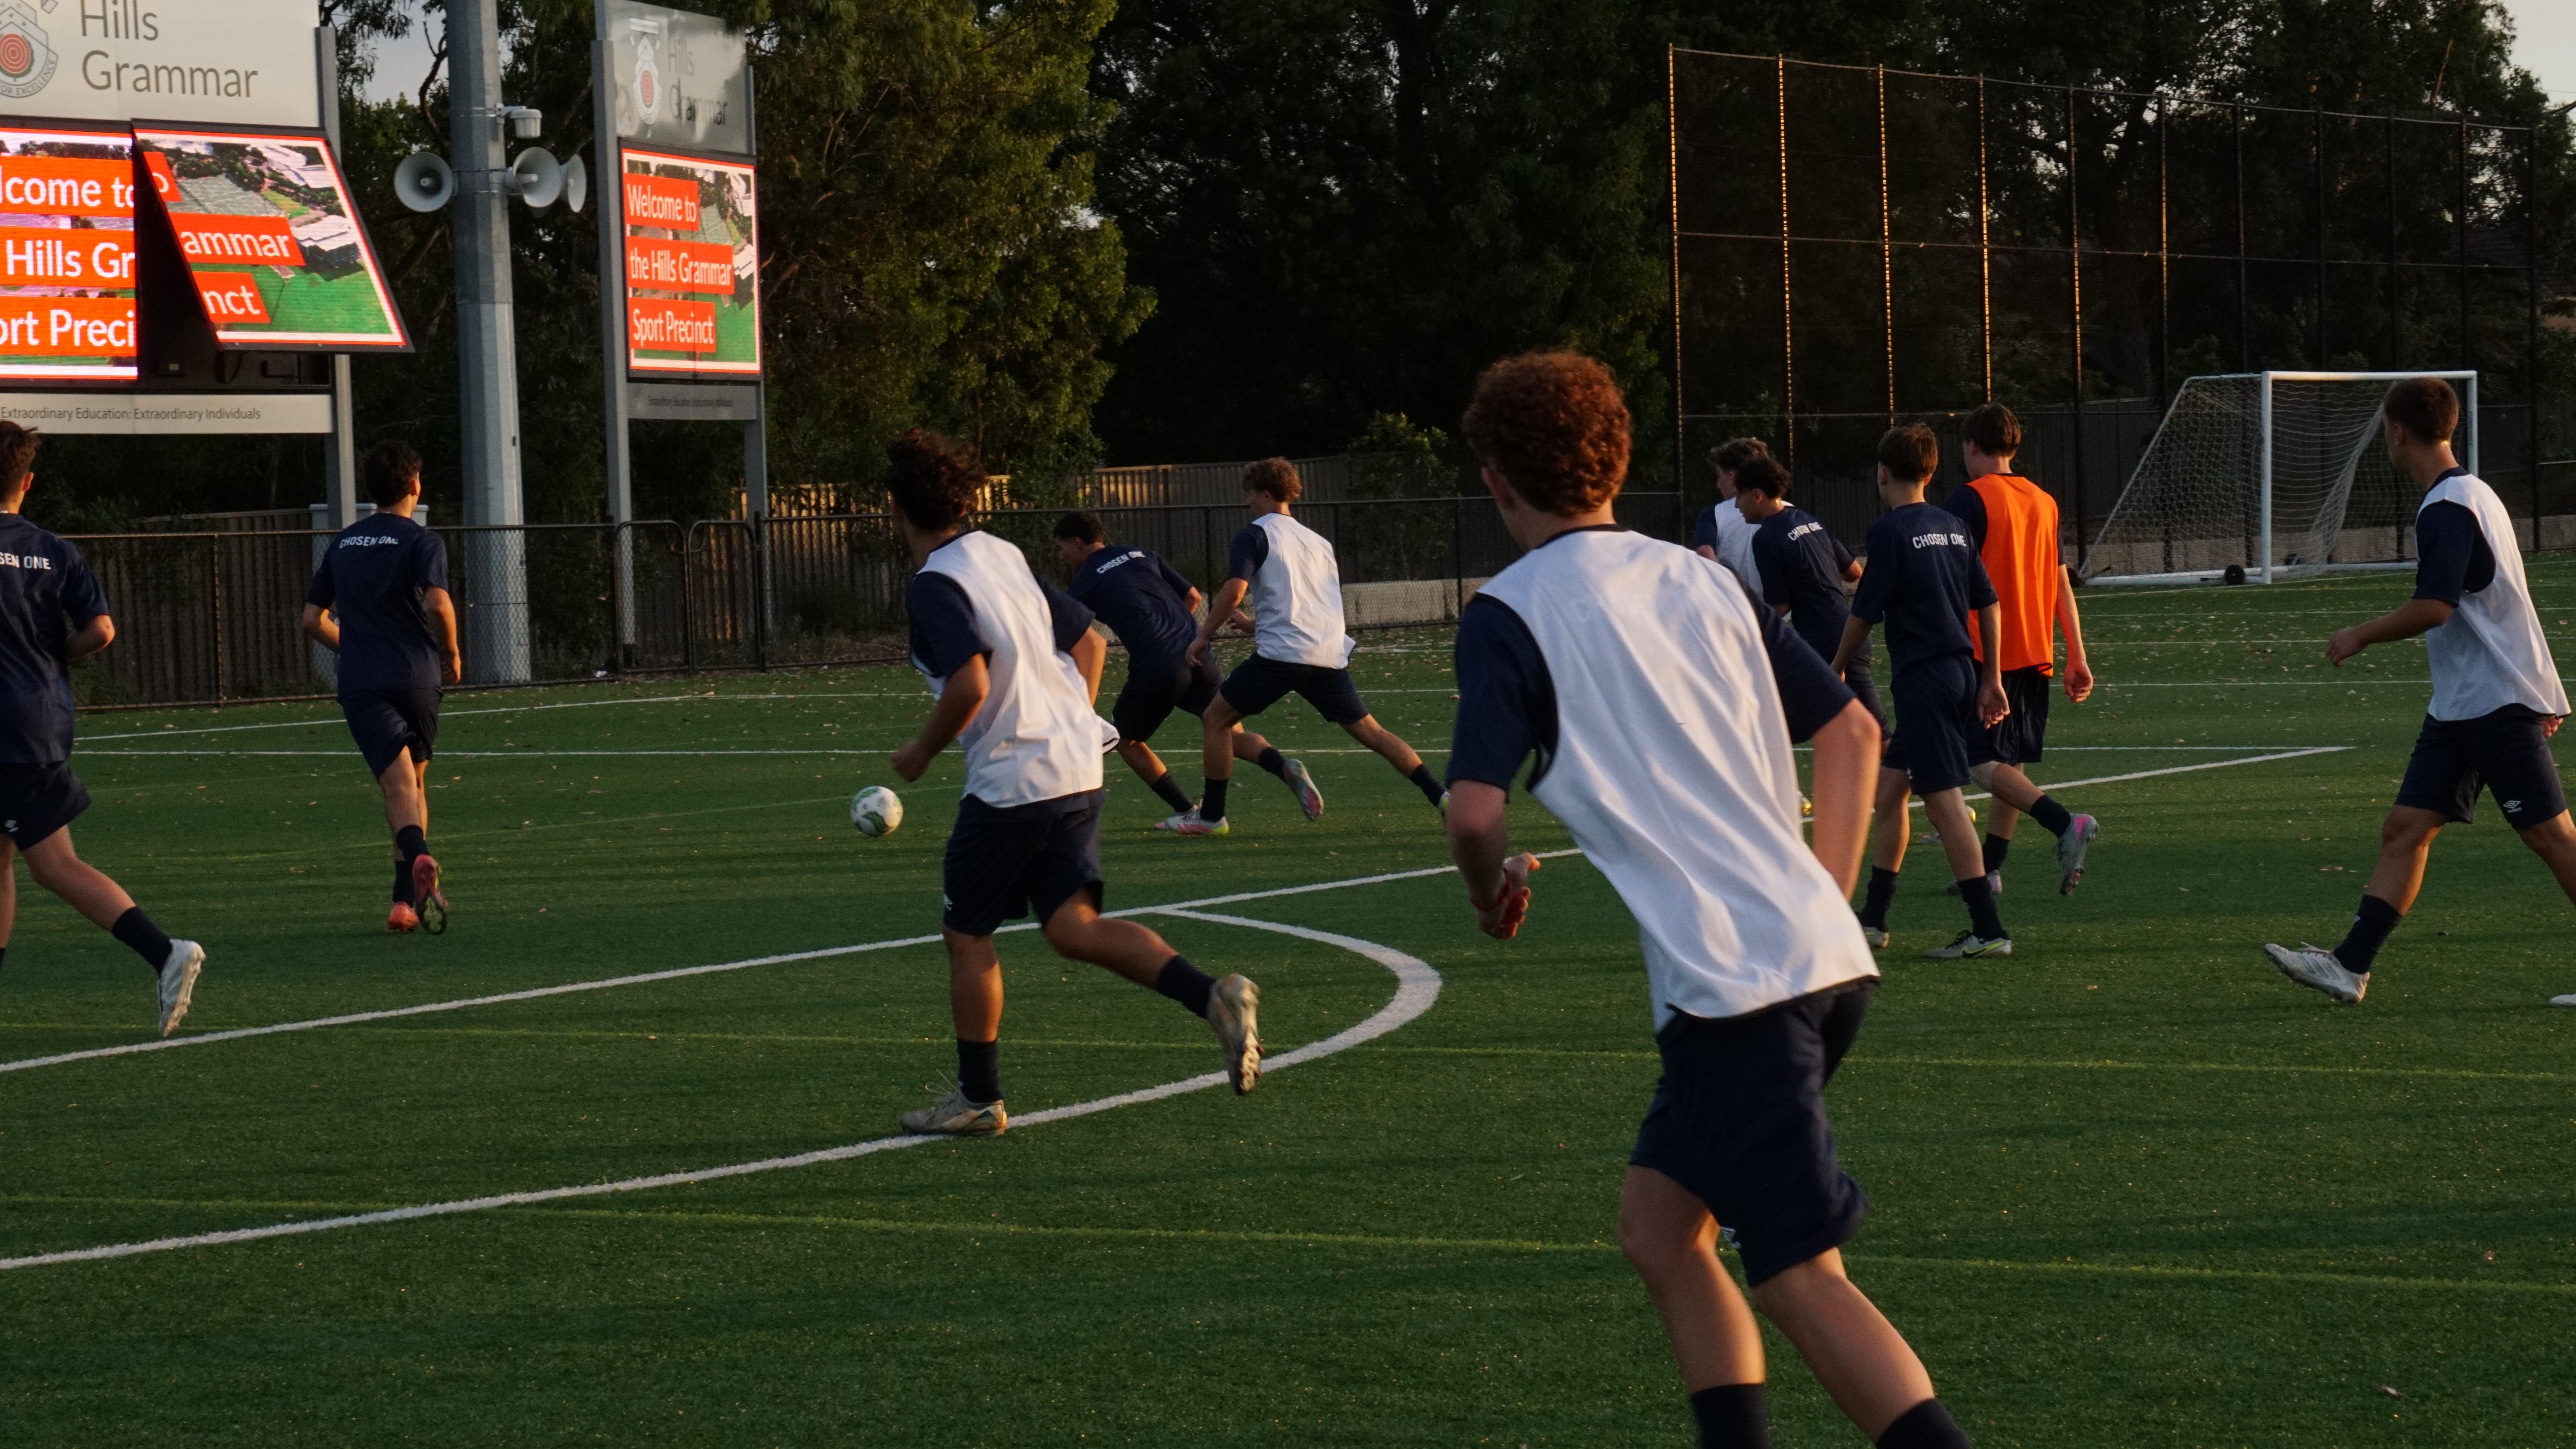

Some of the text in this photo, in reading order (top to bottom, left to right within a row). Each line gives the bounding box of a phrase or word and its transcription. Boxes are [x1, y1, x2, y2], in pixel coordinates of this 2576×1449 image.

[82, 0, 158, 41] Hills
[0, 61, 55, 95] OR EXCELLENCE
[82, 50, 258, 98] Grammar
[627, 184, 697, 222] Welcome to
[6, 240, 82, 277] Hills
[180, 232, 290, 257] ammar
[630, 247, 732, 286] the Hills Grammar
[203, 285, 261, 315] nct
[50, 309, 134, 347] Preci
[633, 309, 714, 347] Sport Precinct
[1, 407, 261, 421] Extraordinary Education: Extraordinary Individuals
[339, 536, 378, 549] CHOSEN
[1913, 533, 1967, 549] CHOSEN ONE
[24, 555, 51, 570] ONE
[1096, 554, 1130, 574] CHOSEN
